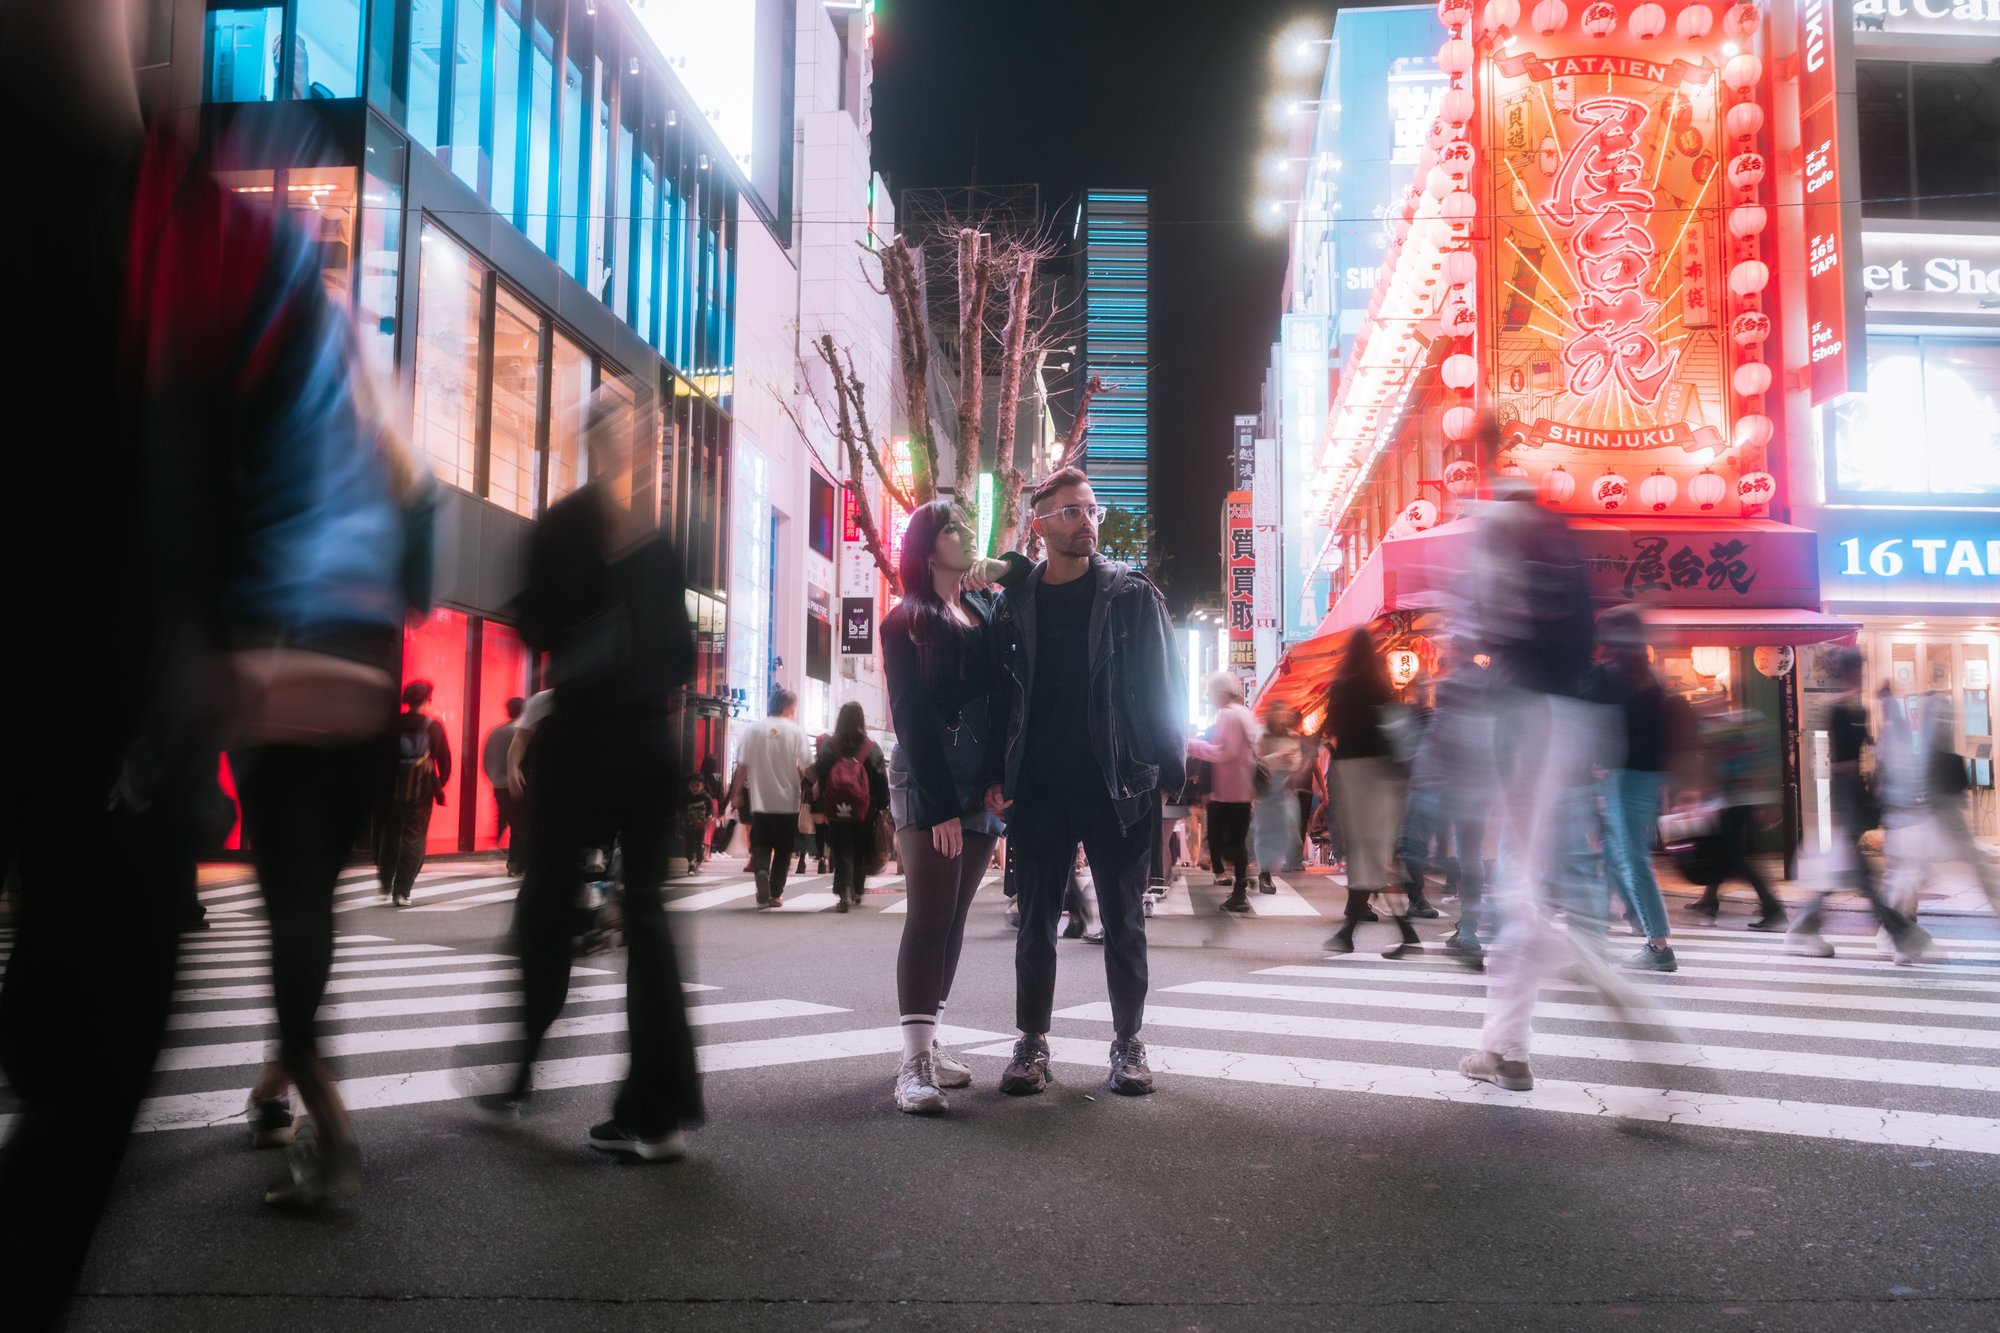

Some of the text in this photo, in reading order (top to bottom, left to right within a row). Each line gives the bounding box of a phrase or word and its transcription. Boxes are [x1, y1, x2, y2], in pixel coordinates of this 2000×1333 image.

[1544, 57, 1666, 81] YATAIEN
[1806, 155, 1827, 177] Cat
[1807, 170, 1834, 193] Cafe
[1541, 97, 1680, 406] 屋台苑
[1811, 235, 1822, 247] 2F
[1810, 244, 1826, 262] 16
[1810, 253, 1837, 278] TAPI
[1811, 321, 1822, 333] 1F
[1812, 328, 1832, 347] Pet
[1812, 341, 1842, 362] Shop
[1548, 425, 1675, 448] SHINJUKU
[1230, 504, 1253, 519] 大黒
[1623, 536, 1758, 596] 屋台苑
[1839, 537, 1904, 577] 16
[1231, 641, 1254, 652] DUT
[1231, 653, 1255, 663] FRE
